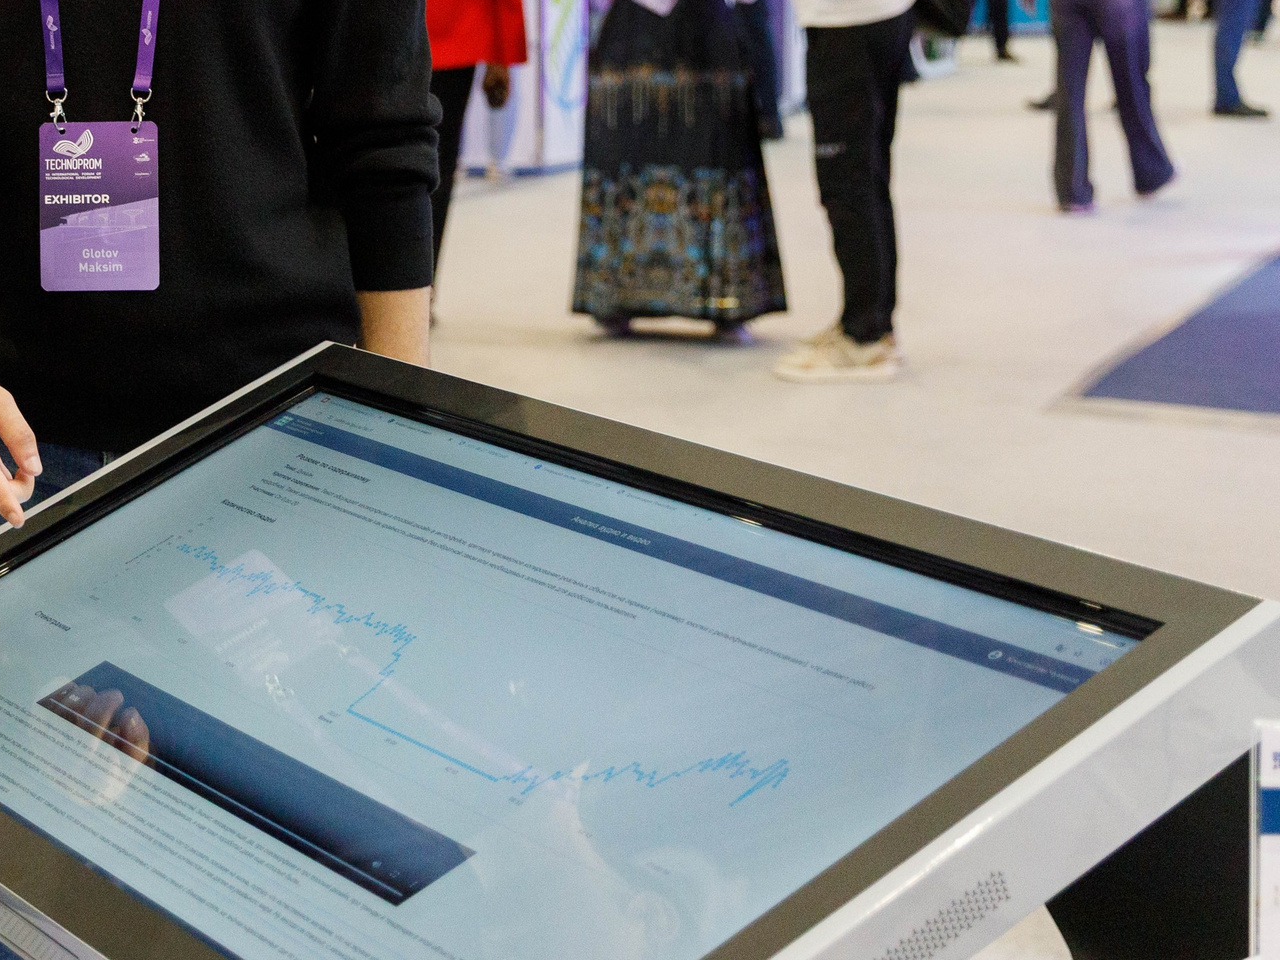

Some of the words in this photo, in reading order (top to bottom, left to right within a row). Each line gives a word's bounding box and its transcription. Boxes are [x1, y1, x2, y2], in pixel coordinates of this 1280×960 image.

[45, 158, 102, 170] TECHNOPROM
[44, 194, 110, 204] EXHIBITOR
[82, 248, 119, 259] Glotov
[78, 262, 123, 272] Maksim
[327, 465, 370, 482] содержимому
[221, 499, 257, 514] Количество
[255, 512, 277, 523] людей
[571, 515, 601, 528] Анализ
[598, 525, 620, 535] аудио
[625, 534, 652, 546] видео
[33, 610, 73, 631] Стенограмма
